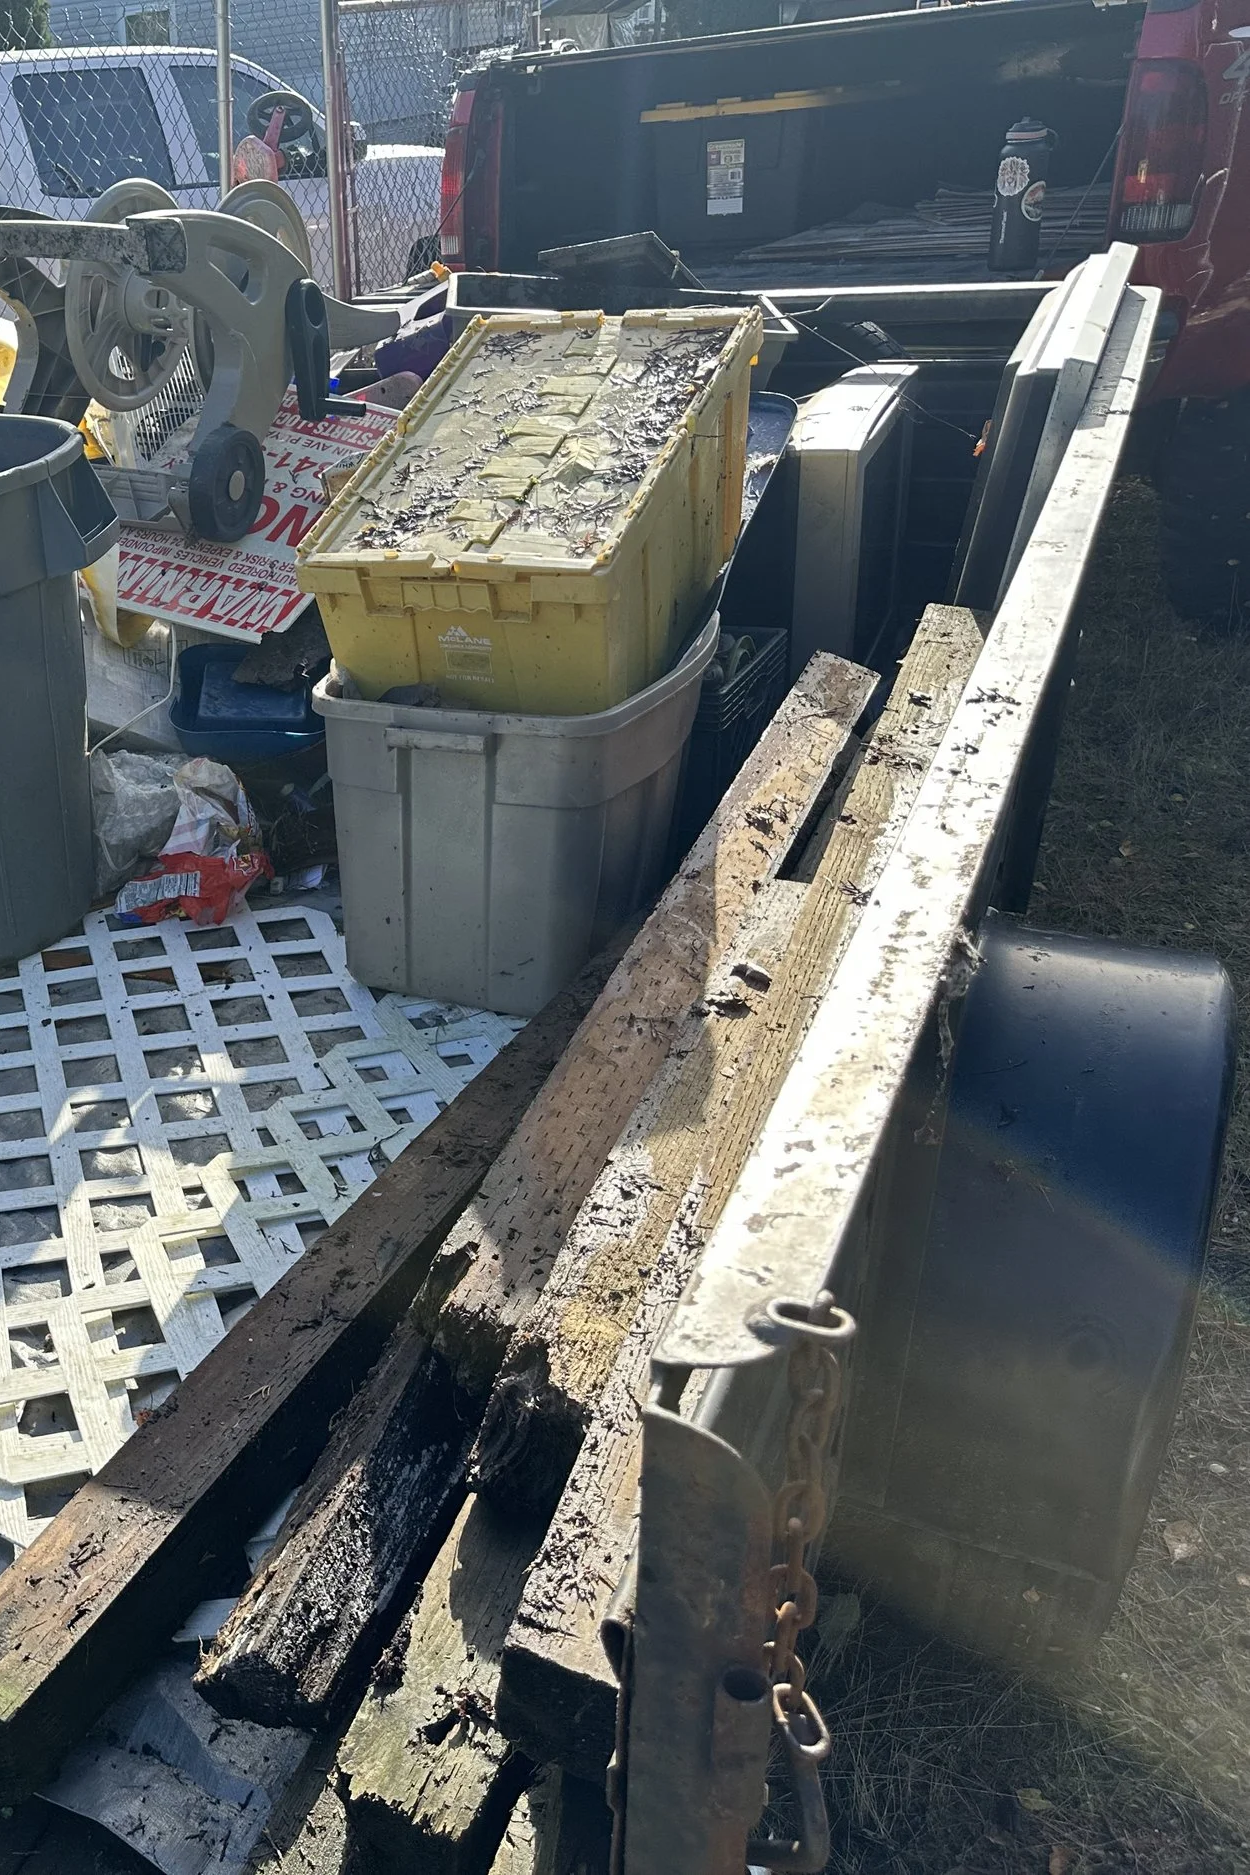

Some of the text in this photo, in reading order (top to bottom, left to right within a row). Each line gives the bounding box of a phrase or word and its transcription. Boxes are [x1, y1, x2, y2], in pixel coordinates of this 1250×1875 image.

[302, 438, 331, 452] AVE
[185, 541, 233, 558] EXPENS
[233, 550, 243, 560] &
[173, 550, 225, 569] VEHICLES
[243, 552, 269, 567] RISK
[270, 559, 297, 573] ER'S
[227, 562, 298, 586] AUTHORIZED
[118, 557, 289, 628] WARNIN
